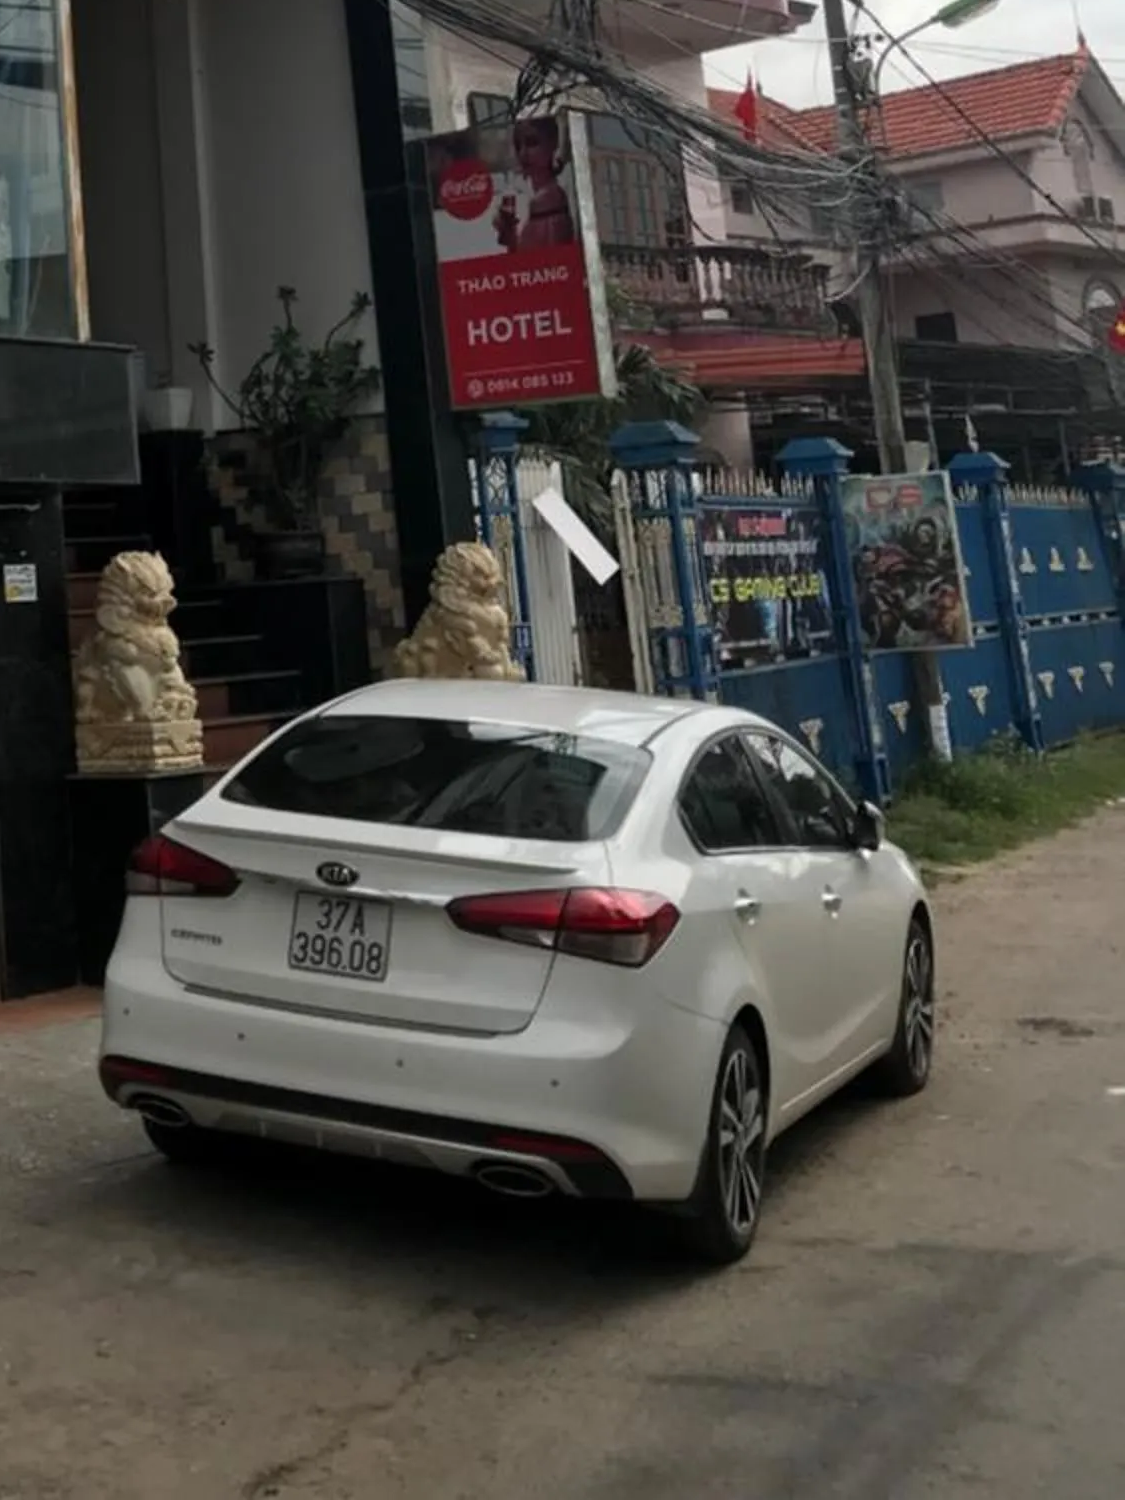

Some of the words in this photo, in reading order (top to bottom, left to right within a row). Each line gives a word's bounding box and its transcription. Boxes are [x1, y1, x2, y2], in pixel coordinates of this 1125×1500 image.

[509, 265, 570, 288] TRANG
[467, 308, 572, 347] HOTEL
[321, 865, 353, 884] KIA
[316, 899, 366, 938] 37A
[291, 931, 383, 975] 396.08
